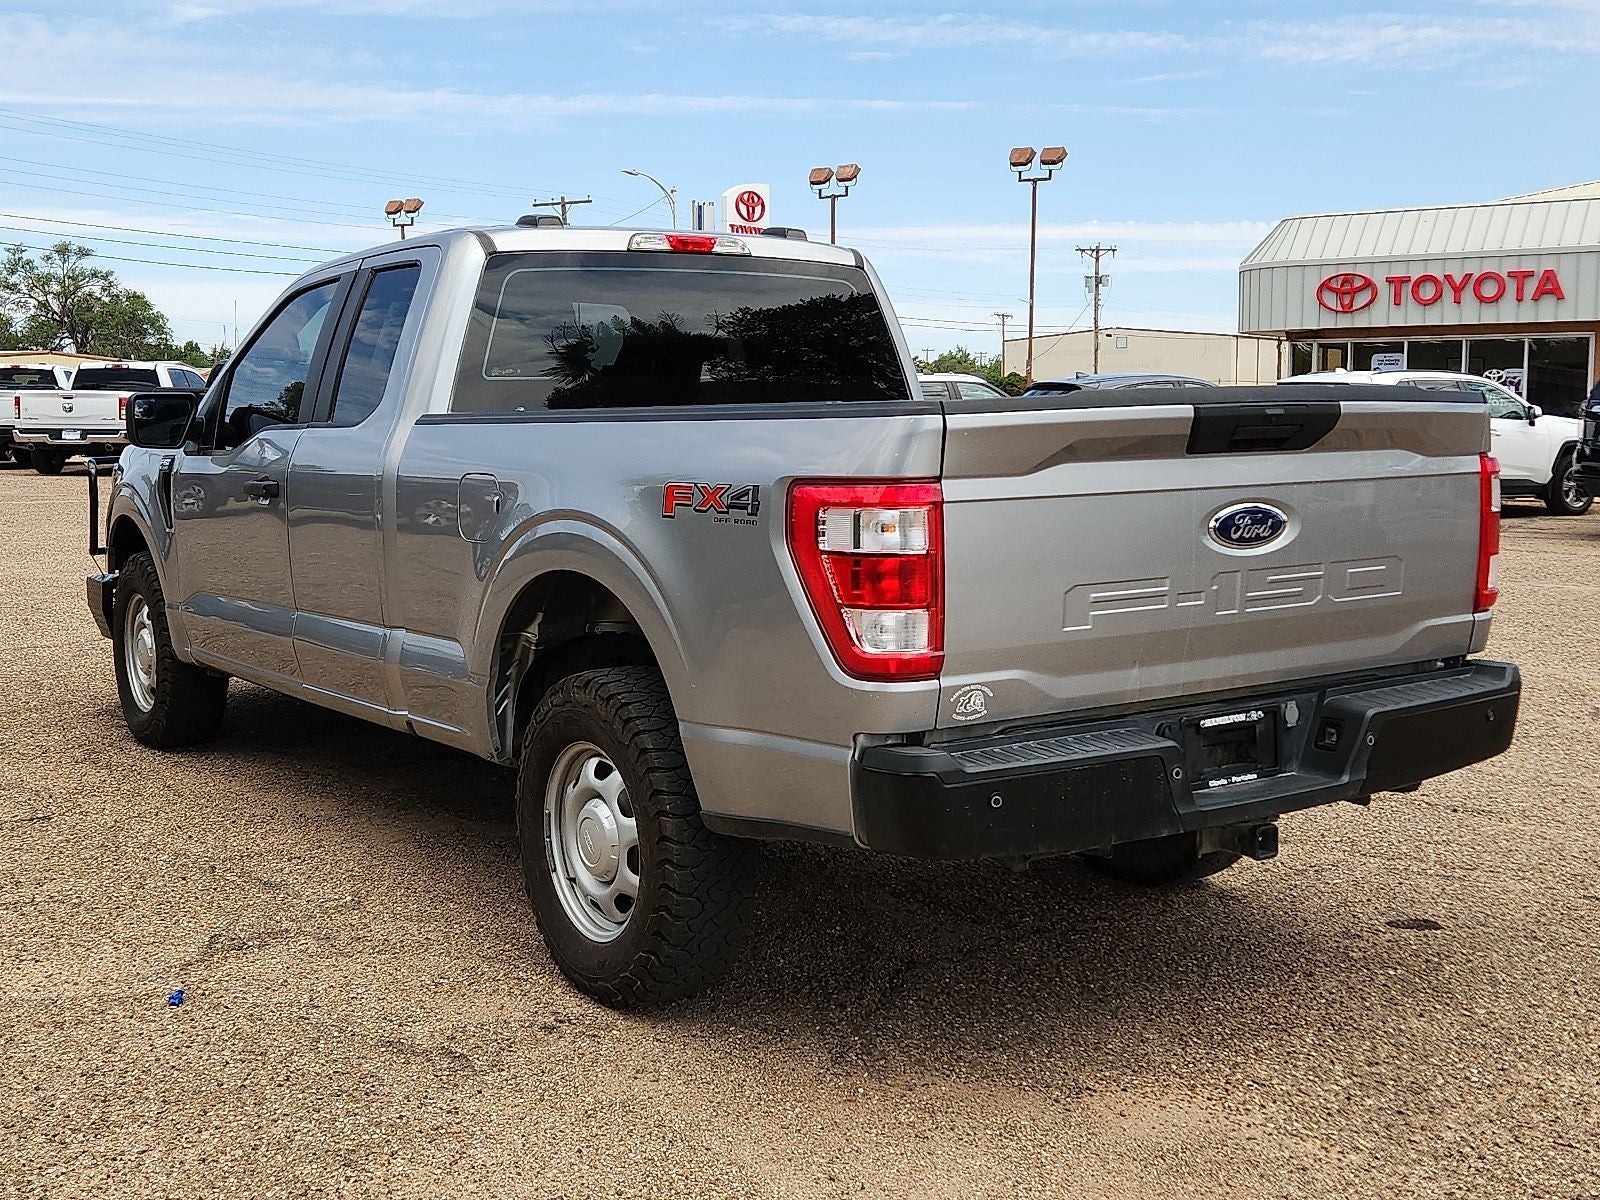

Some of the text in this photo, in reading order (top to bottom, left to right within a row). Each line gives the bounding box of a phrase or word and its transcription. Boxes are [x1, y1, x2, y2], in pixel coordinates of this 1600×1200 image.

[729, 224, 763, 234] TOYOT
[1385, 269, 1565, 306] TOYOTA
[662, 482, 760, 519] FX4
[713, 516, 758, 526] OFF ROAD
[1231, 513, 1273, 540] Ford
[1063, 555, 1403, 632] F-150
